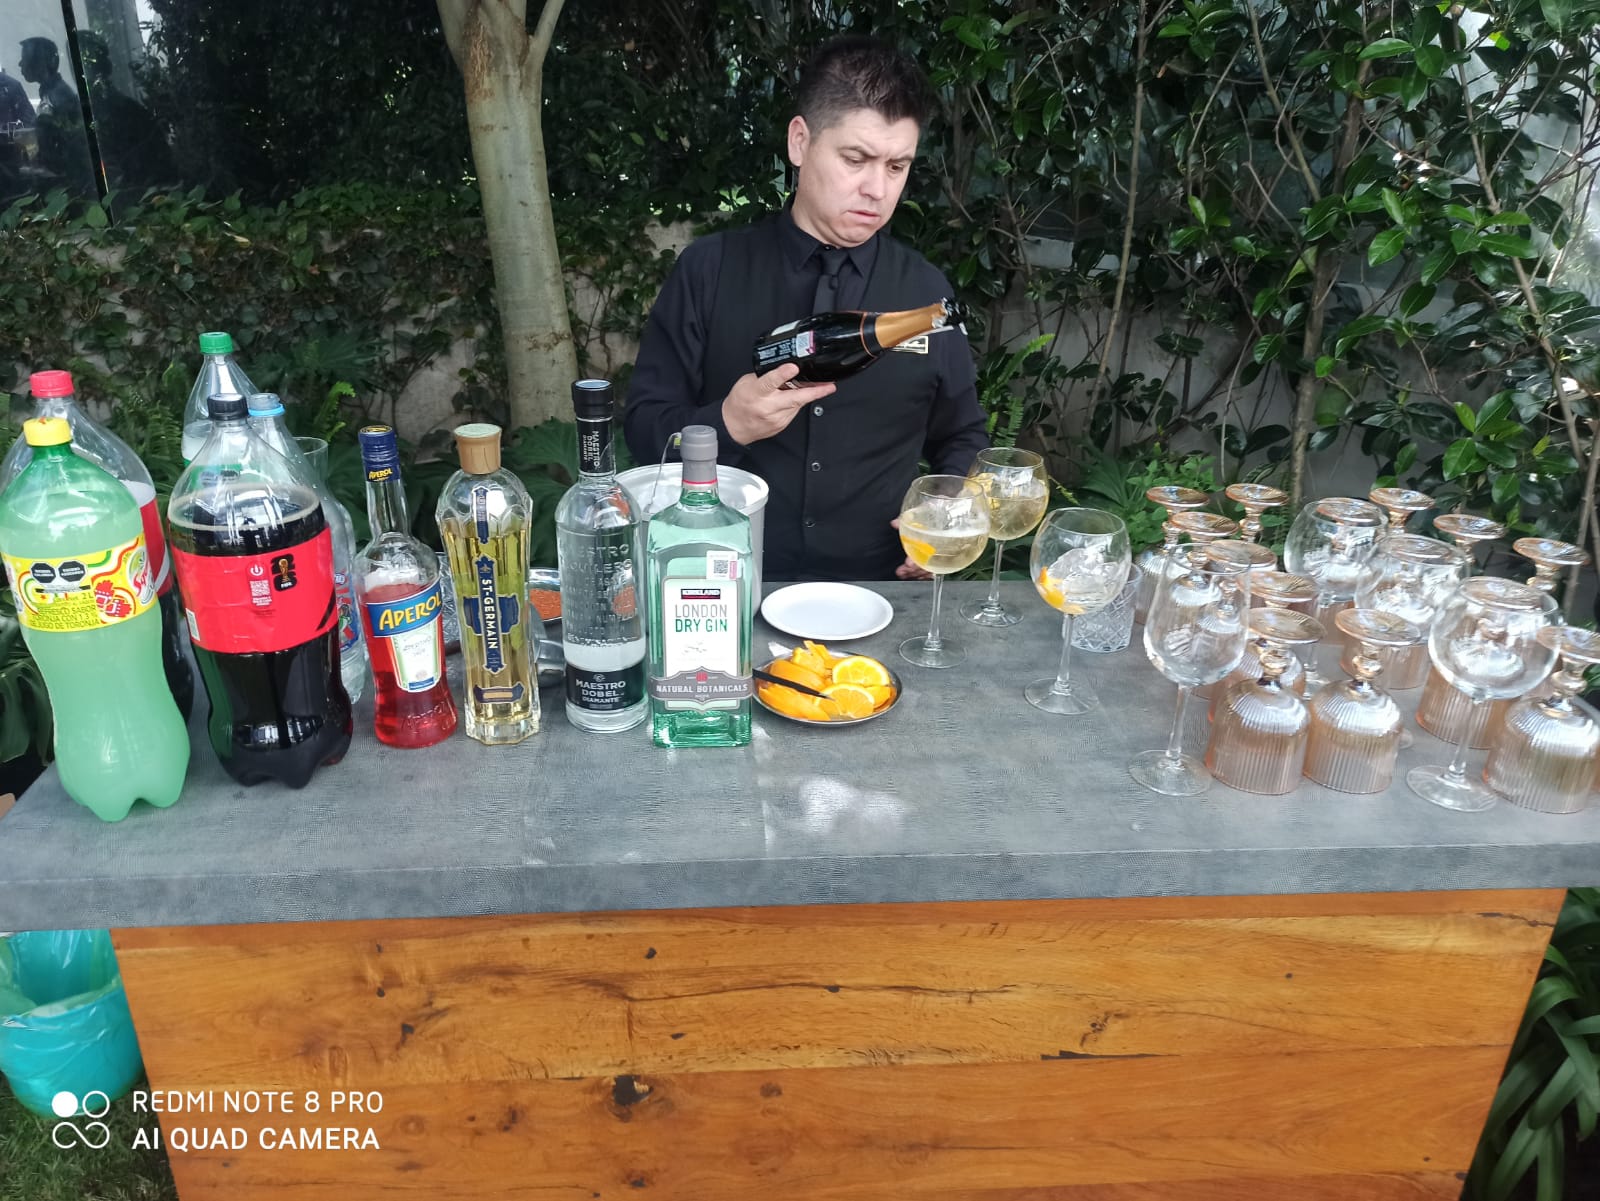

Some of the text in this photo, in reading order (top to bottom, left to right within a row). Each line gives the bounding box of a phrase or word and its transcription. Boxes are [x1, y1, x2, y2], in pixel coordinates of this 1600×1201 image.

[592, 430, 601, 467] MAESTRO
[368, 467, 393, 479] APEROL
[379, 592, 442, 631] APEROL
[481, 578, 499, 649] ST-GERMAIN
[675, 604, 728, 618] LONDON
[675, 619, 728, 633] DRY GIN
[575, 679, 627, 690] MAESTRO
[656, 683, 749, 693] NATURAL BOTANICALS
[581, 689, 620, 698] DOBEL
